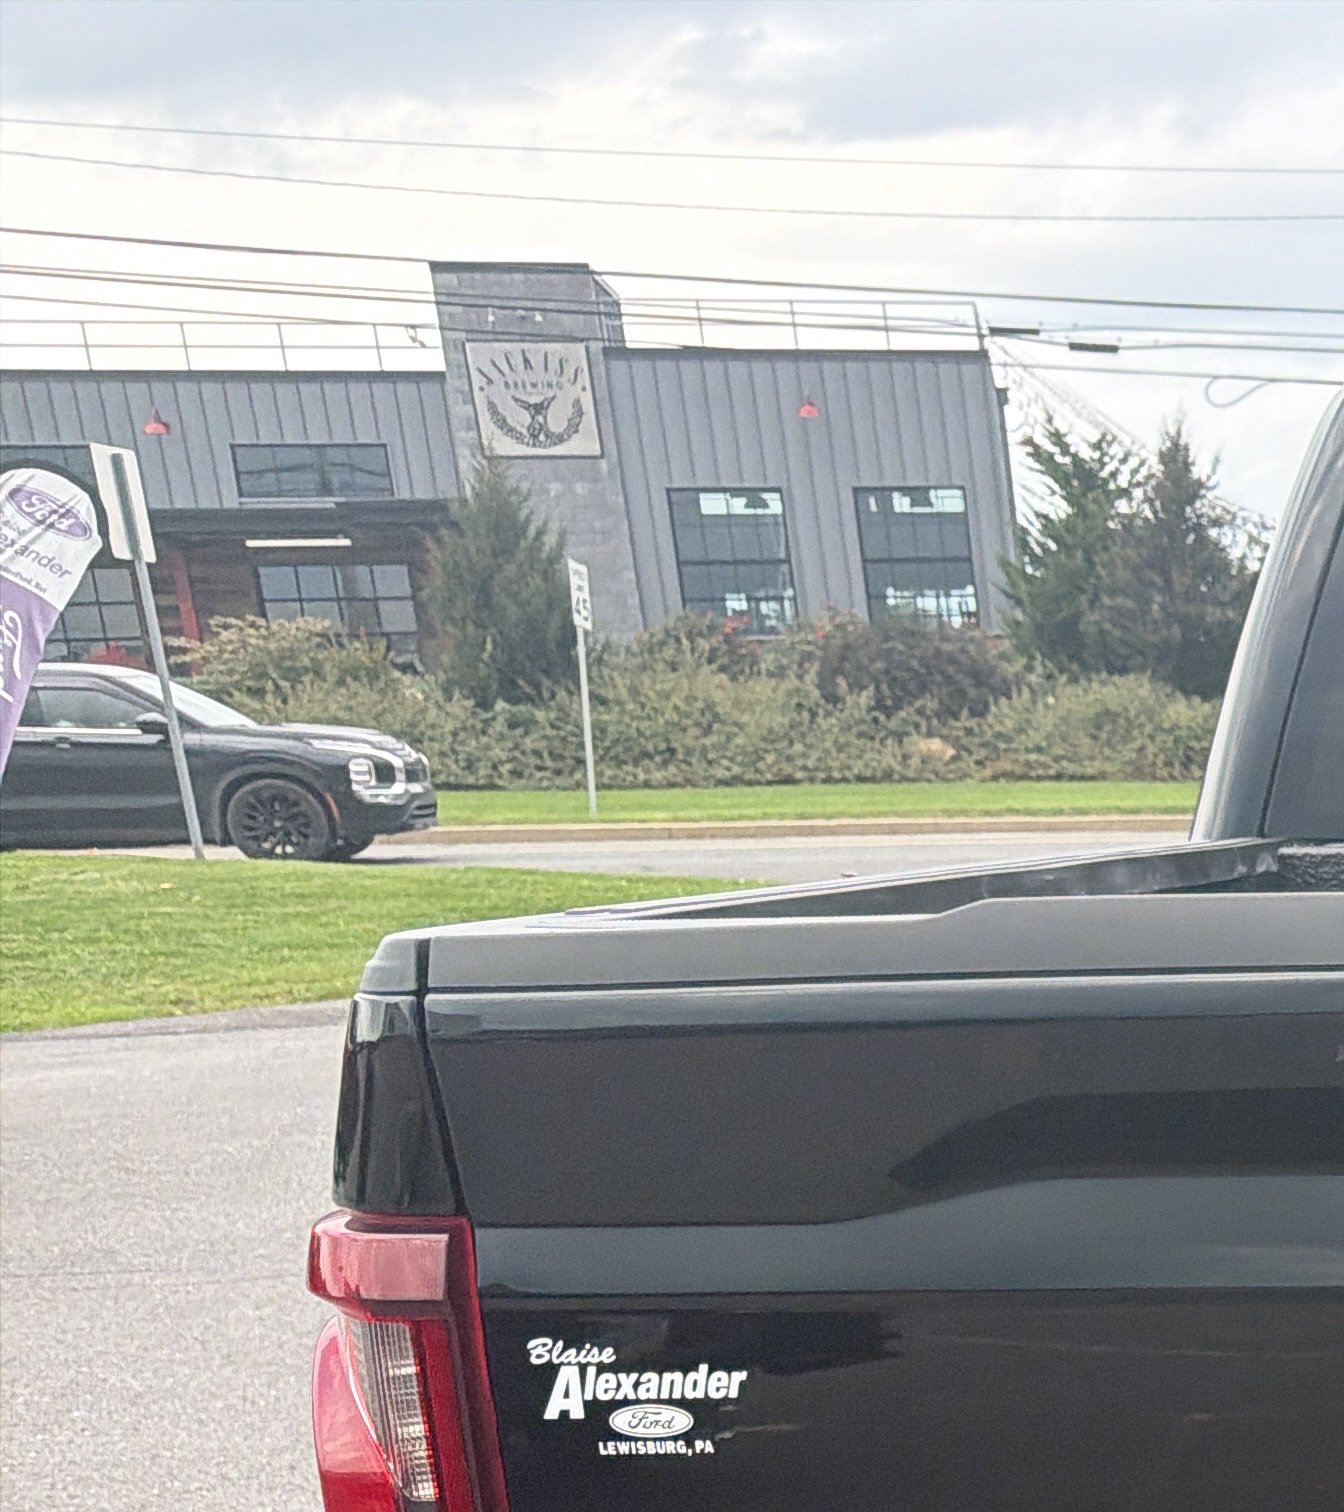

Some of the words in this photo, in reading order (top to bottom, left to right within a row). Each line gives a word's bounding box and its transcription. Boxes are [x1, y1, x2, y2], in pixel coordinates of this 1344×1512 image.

[575, 595, 589, 622] 45
[527, 1338, 616, 1365] Blaise
[544, 1364, 747, 1420] Alexander
[628, 1411, 675, 1430] Ford
[598, 1440, 692, 1457] LEWISBURG,
[695, 1440, 715, 1454] PA
